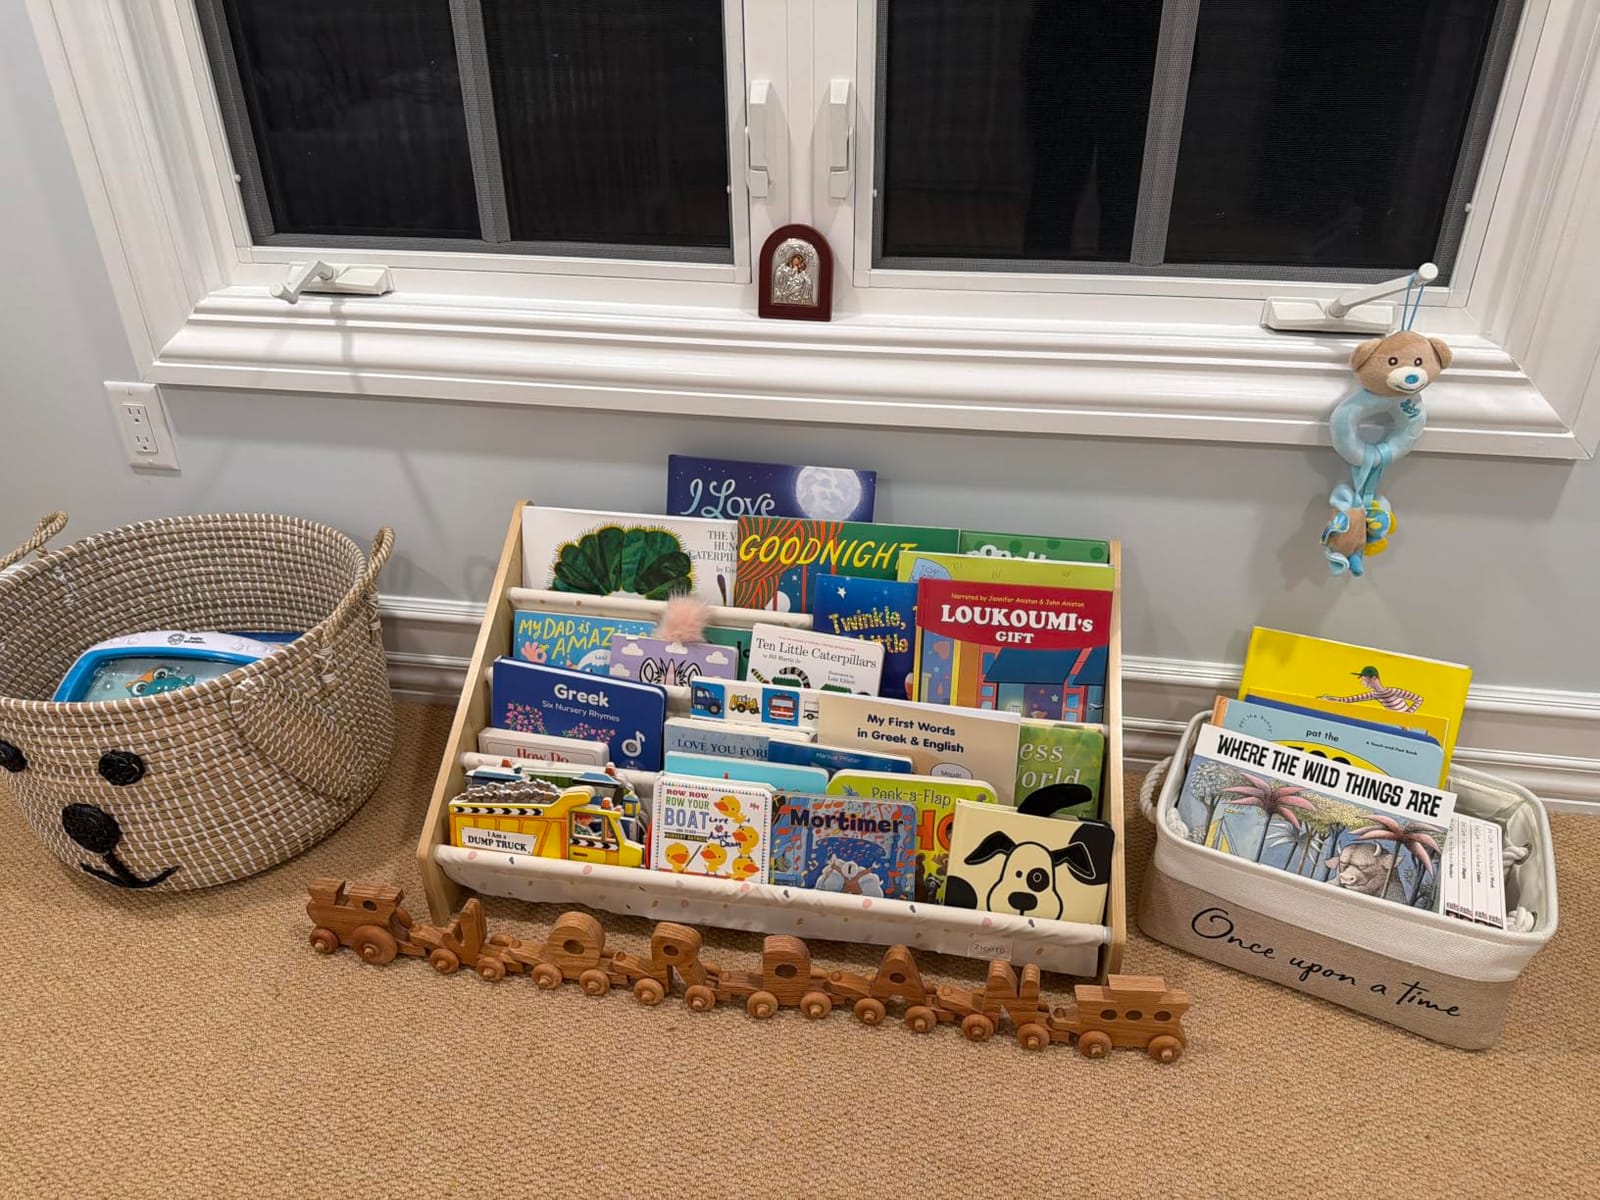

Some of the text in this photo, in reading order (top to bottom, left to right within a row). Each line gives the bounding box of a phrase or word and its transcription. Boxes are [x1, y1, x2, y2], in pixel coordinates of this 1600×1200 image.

[680, 479, 775, 520] I Love
[707, 530, 728, 540] THE
[714, 541, 736, 551] HUN
[689, 550, 736, 562] CATERPIL
[543, 618, 576, 640] DAD
[828, 605, 907, 634] Twinkle,
[940, 604, 1093, 633] LOUKOUMI's
[552, 627, 646, 660] AMAZ
[995, 631, 1034, 644] GIFT
[756, 638, 776, 651] Ten
[780, 642, 809, 657] Little
[811, 647, 877, 669] Caterpillars
[553, 683, 609, 708] Greek
[542, 700, 620, 723] Six Nursery Rhymes
[866, 713, 956, 736] My First Words
[1305, 729, 1339, 742] pat the
[677, 738, 707, 751] LOVE
[710, 743, 736, 755] YOU
[857, 727, 965, 754] in Greek & English
[516, 748, 569, 764] How Do
[1019, 743, 1064, 763] ess
[1017, 765, 1081, 789] orld
[1216, 734, 1267, 768] WHERE
[1271, 749, 1300, 776] THE
[1302, 759, 1340, 789] WILD
[1345, 771, 1404, 808] THINGS
[1405, 788, 1443, 818] ARE
[665, 796, 710, 810] ROW YOUR
[871, 786, 951, 809] Peek-a-Flap
[664, 807, 710, 830] BOAT
[790, 809, 904, 833] Mortimer
[467, 835, 527, 852] DUMP TRUCK
[1191, 907, 1461, 1017] Once upon a time
